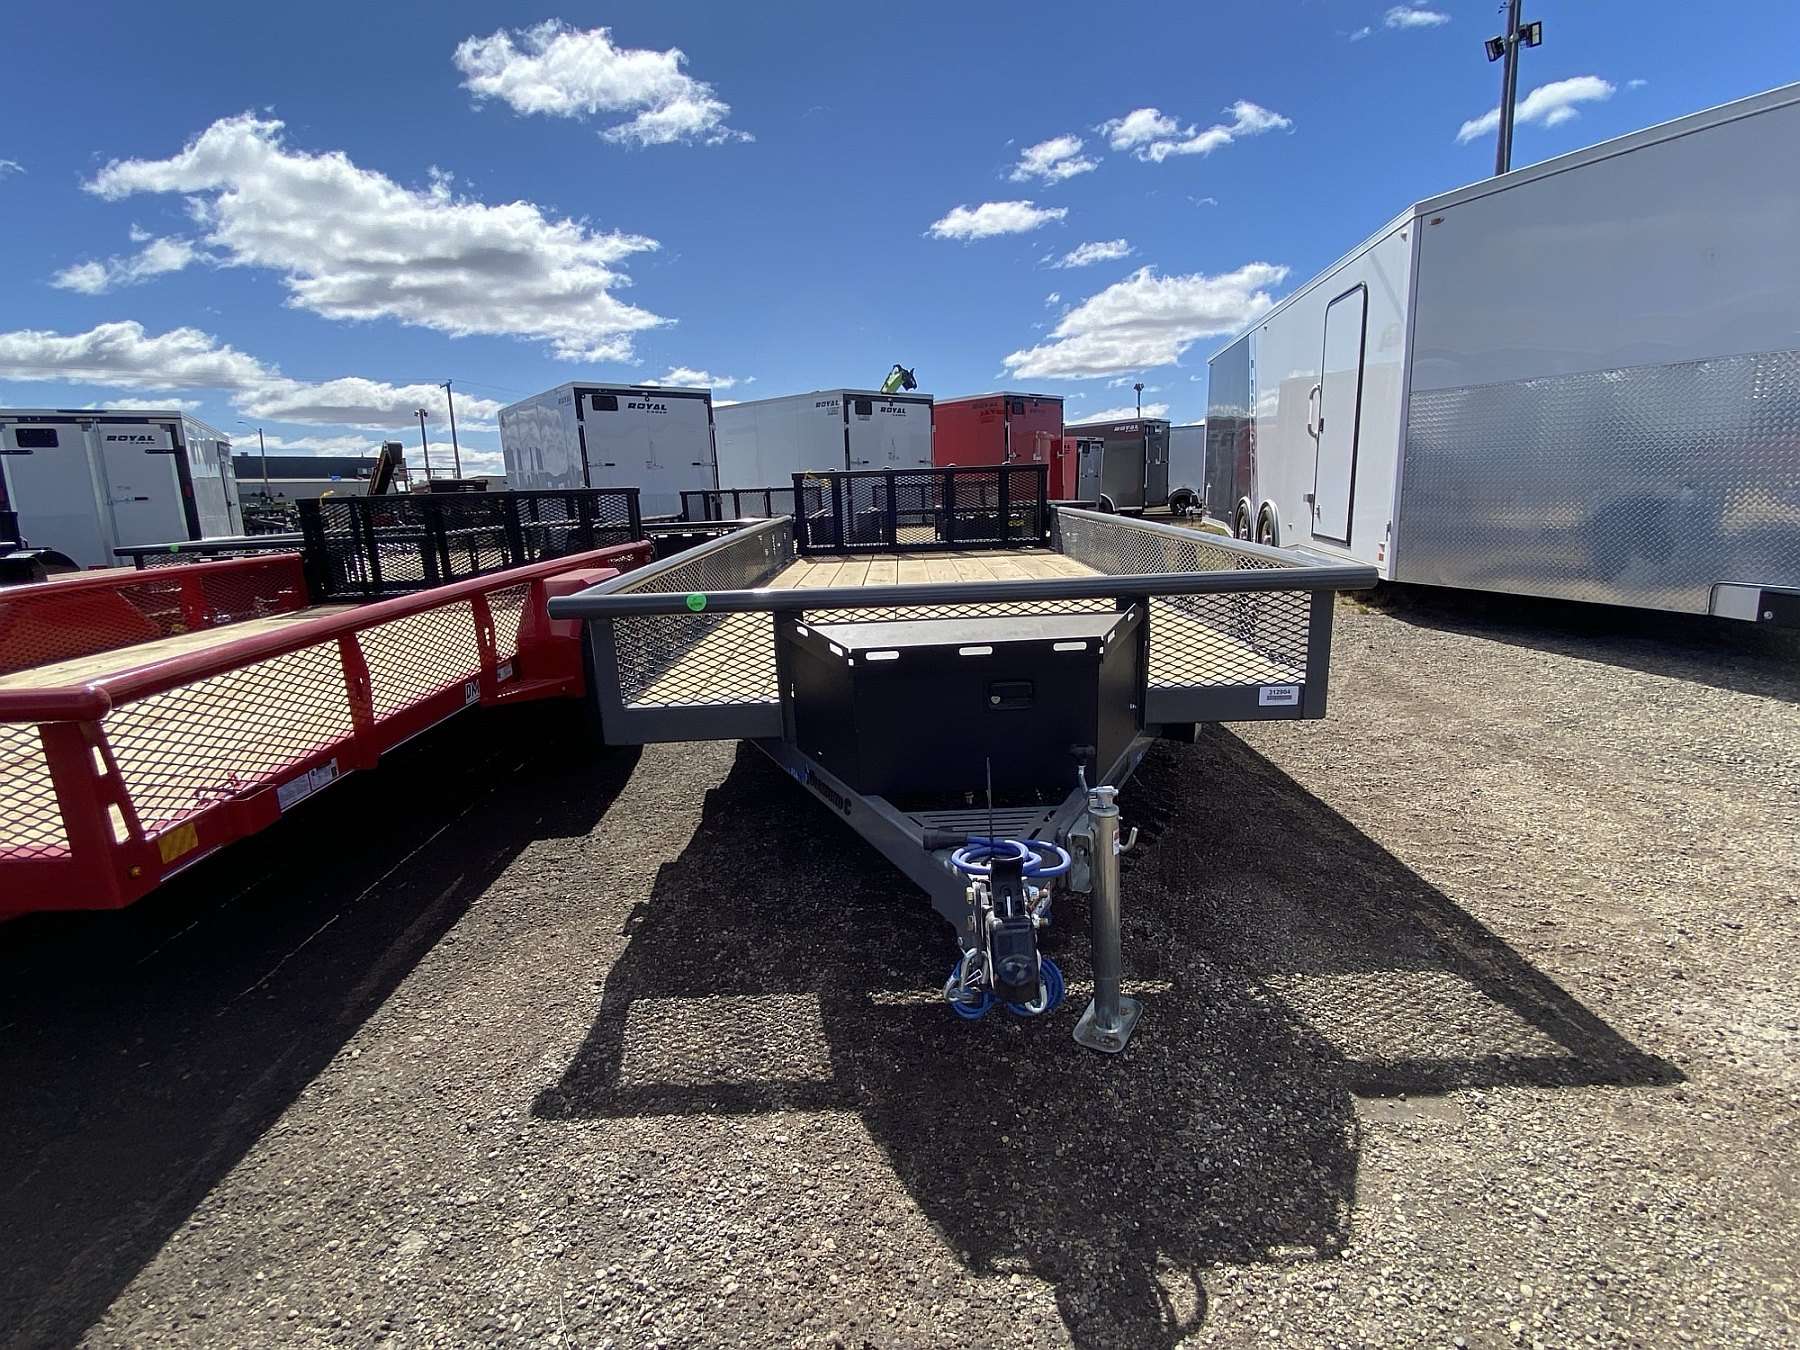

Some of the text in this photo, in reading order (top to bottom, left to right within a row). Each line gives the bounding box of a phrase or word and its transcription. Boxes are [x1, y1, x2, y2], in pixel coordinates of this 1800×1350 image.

[628, 402, 667, 410] ROYAL
[816, 400, 840, 408] ROYAL
[880, 406, 906, 414] ROYAL
